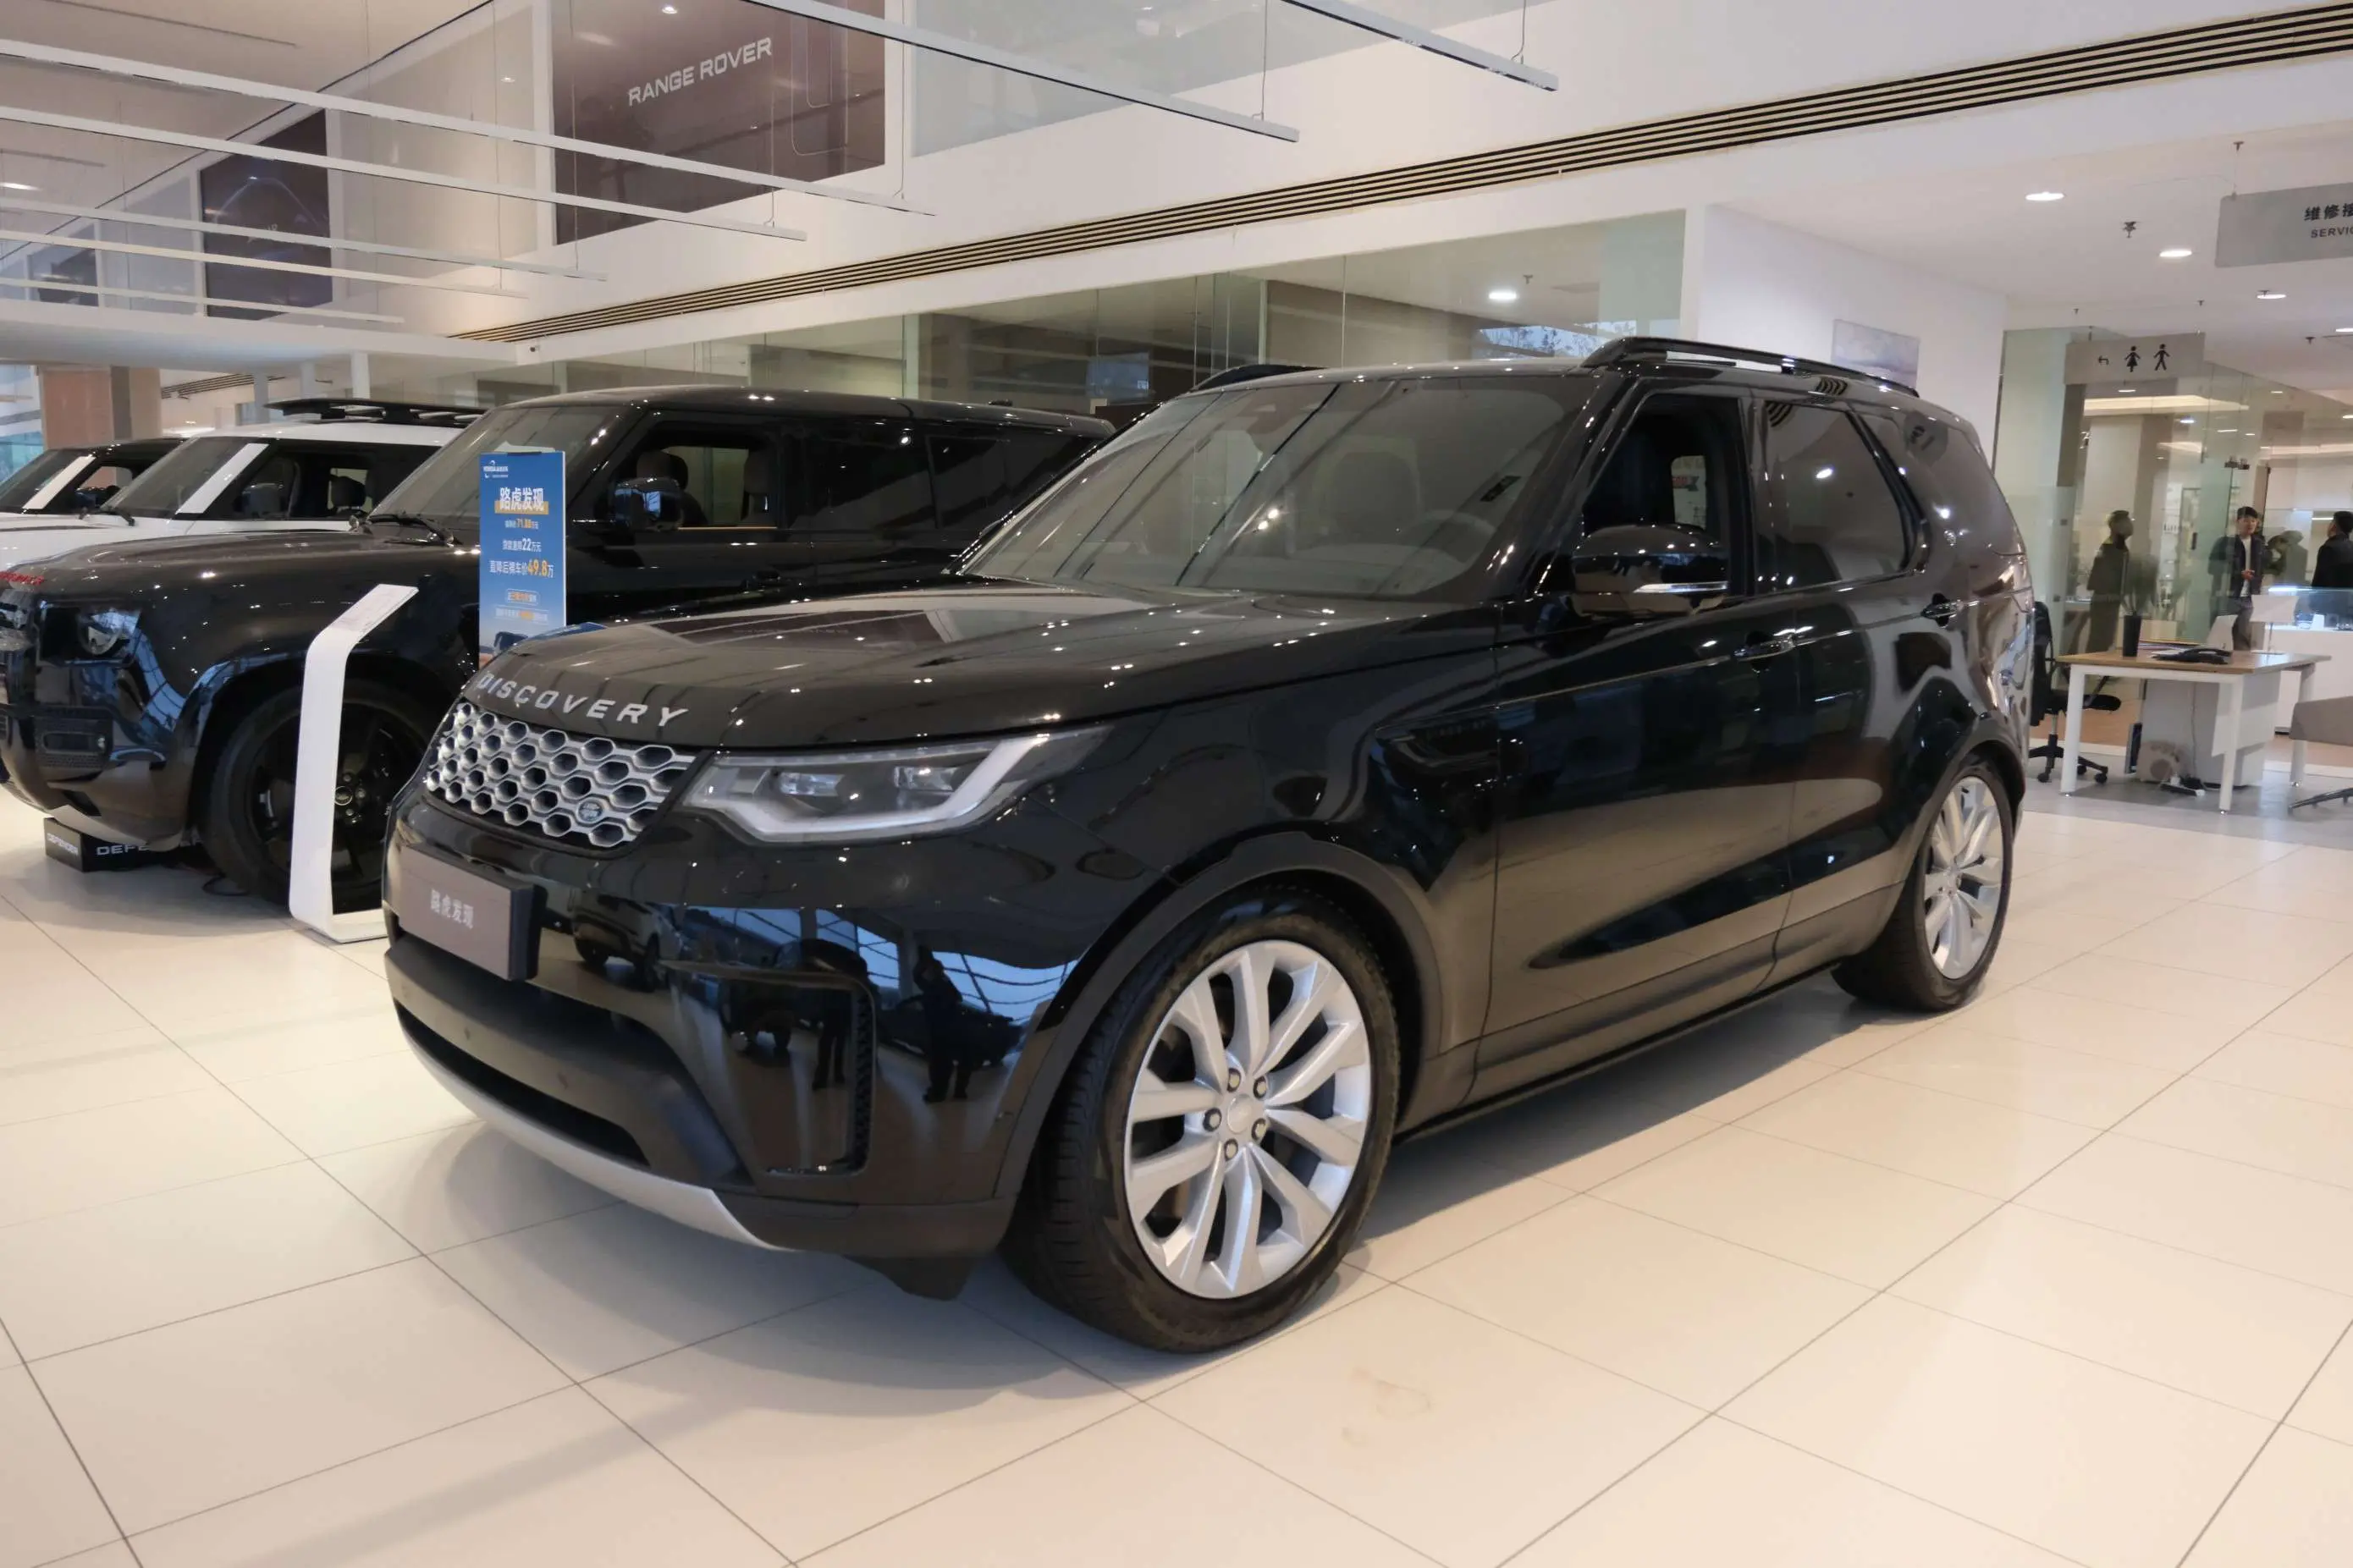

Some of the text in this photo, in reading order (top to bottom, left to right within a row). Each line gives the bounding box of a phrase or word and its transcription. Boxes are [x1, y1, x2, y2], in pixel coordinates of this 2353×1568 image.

[628, 37, 772, 106] RANGE ROVER
[499, 487, 544, 511] 路虎发现
[476, 672, 689, 727] DISCOVERY
[430, 888, 474, 930] 路虎发现
